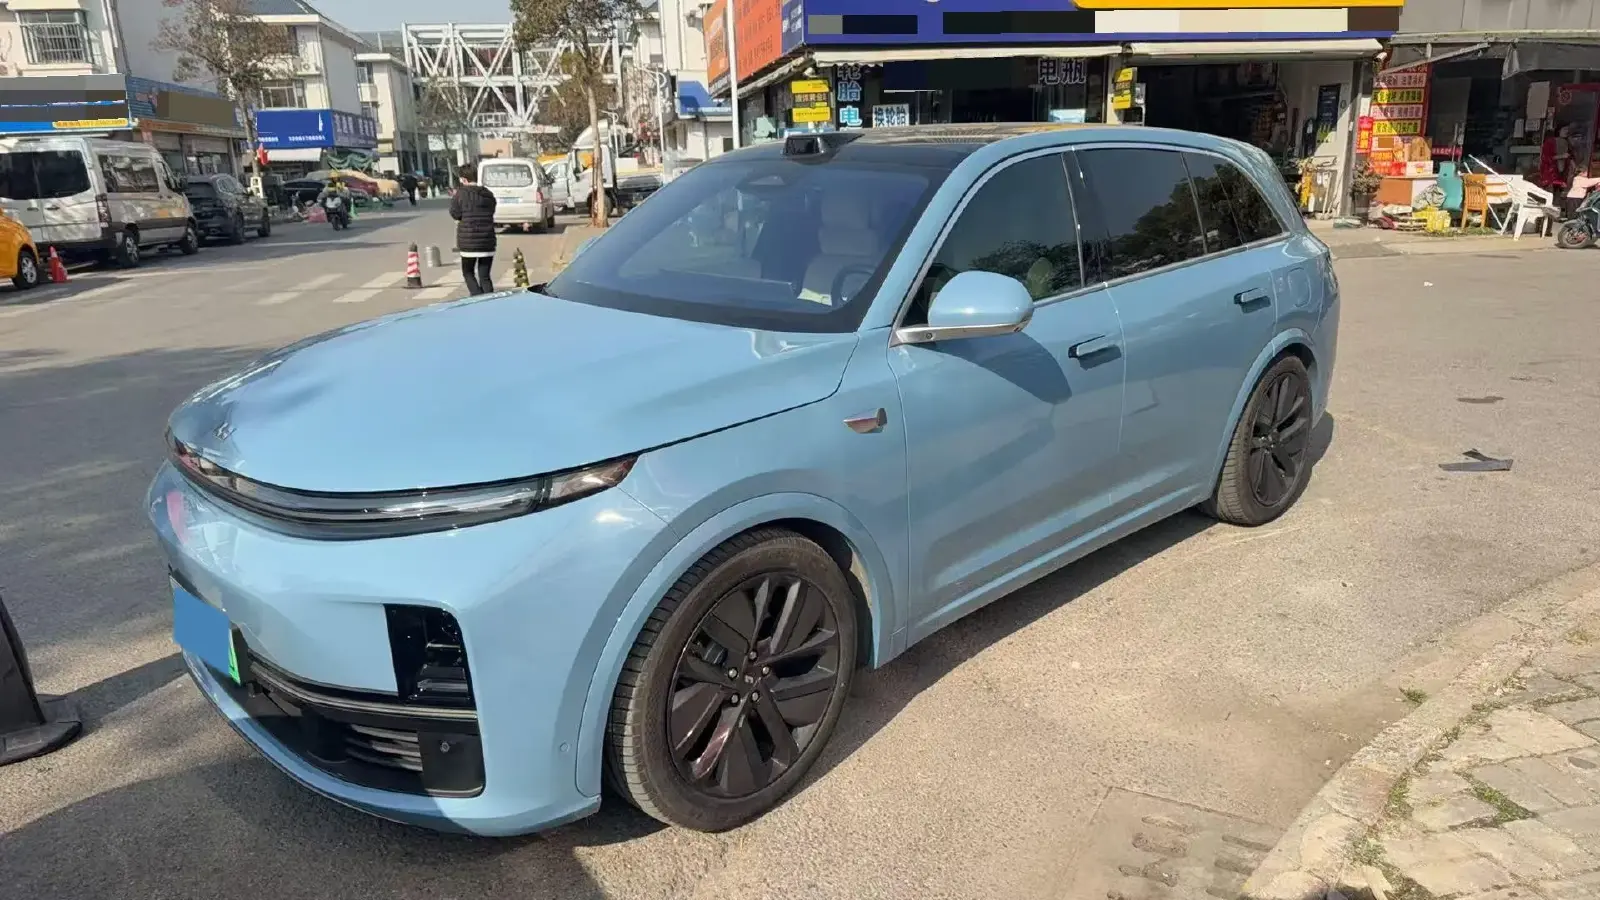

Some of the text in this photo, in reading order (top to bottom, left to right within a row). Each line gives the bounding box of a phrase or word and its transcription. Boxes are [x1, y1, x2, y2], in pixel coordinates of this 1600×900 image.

[1038, 58, 1086, 85] 电瓶
[837, 64, 863, 130] 轮胎电
[875, 106, 907, 126] 换轮胎
